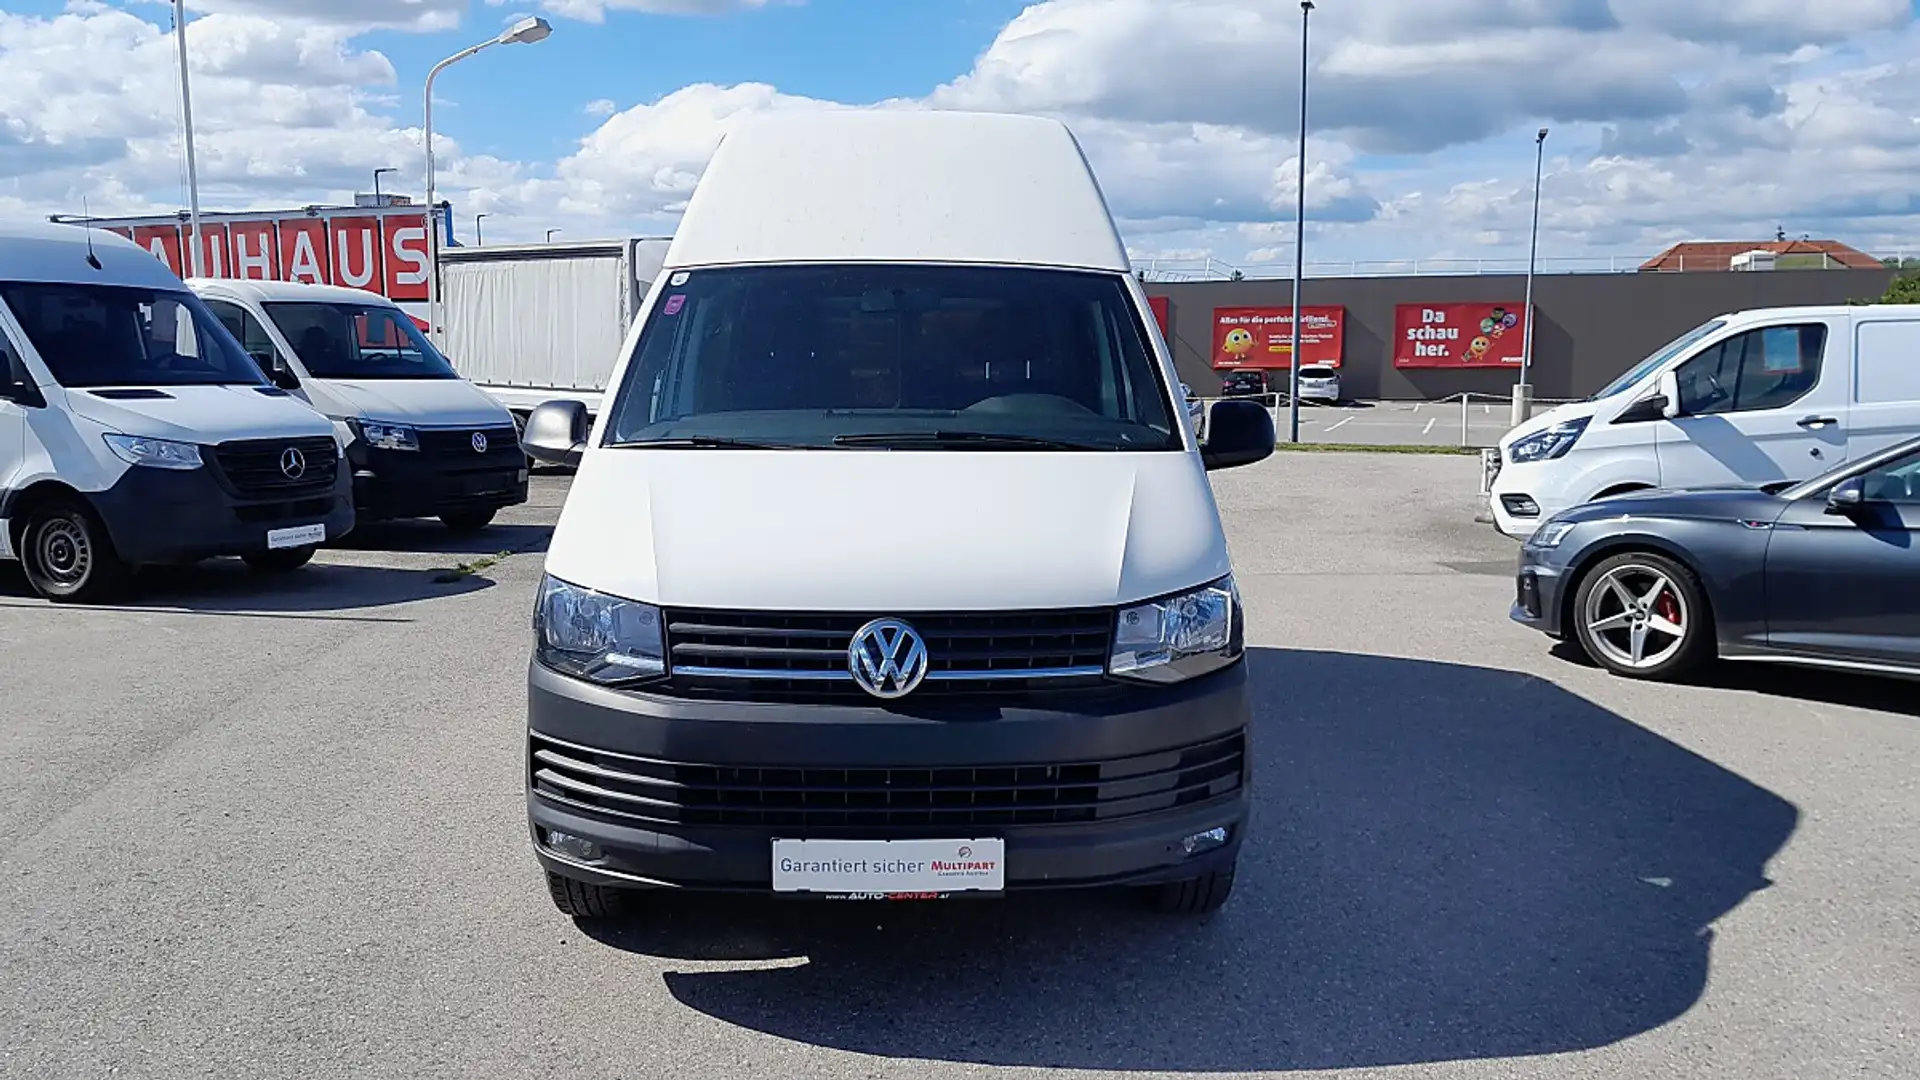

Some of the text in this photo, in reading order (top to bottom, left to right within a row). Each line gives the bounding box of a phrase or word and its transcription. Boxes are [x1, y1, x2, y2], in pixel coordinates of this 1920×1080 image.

[148, 226, 430, 287] AUHAUS
[1264, 314, 1294, 324] perfekt
[1422, 308, 1445, 323] Da
[1407, 325, 1458, 340] schau
[1415, 341, 1450, 356] her.
[851, 620, 924, 695] VW
[780, 857, 926, 873] Garantiert sicher
[931, 860, 996, 871] MULTIPART
